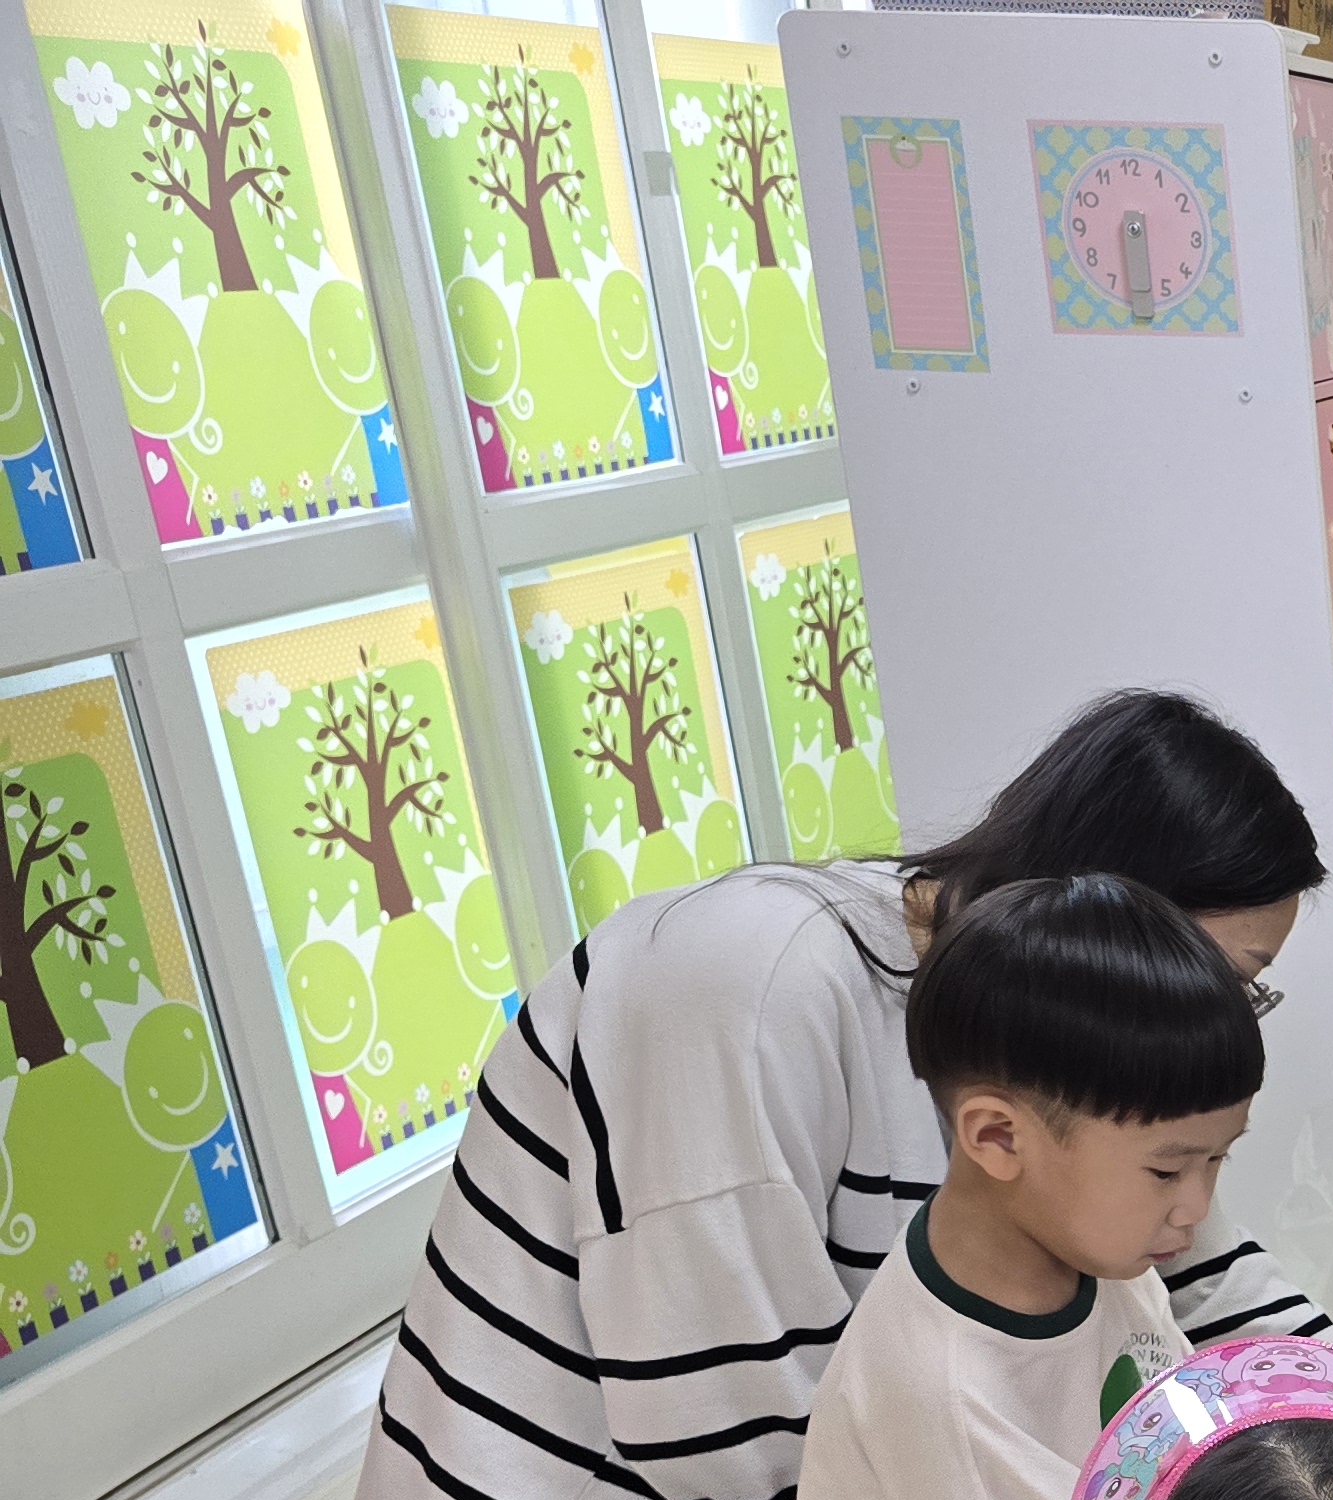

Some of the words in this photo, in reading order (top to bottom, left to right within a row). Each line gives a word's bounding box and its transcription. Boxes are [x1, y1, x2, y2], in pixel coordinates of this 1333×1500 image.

[1096, 169, 1110, 185] 11
[1120, 159, 1141, 177] 12
[1154, 169, 1163, 188] 1
[1075, 191, 1099, 208] 10
[1175, 193, 1191, 213] 2
[1072, 217, 1087, 237] 9
[1190, 231, 1202, 249] 3
[1086, 247, 1098, 267] 8
[1179, 262, 1192, 279] 4
[1107, 273, 1117, 290] 7
[1161, 279, 1171, 297] 5
